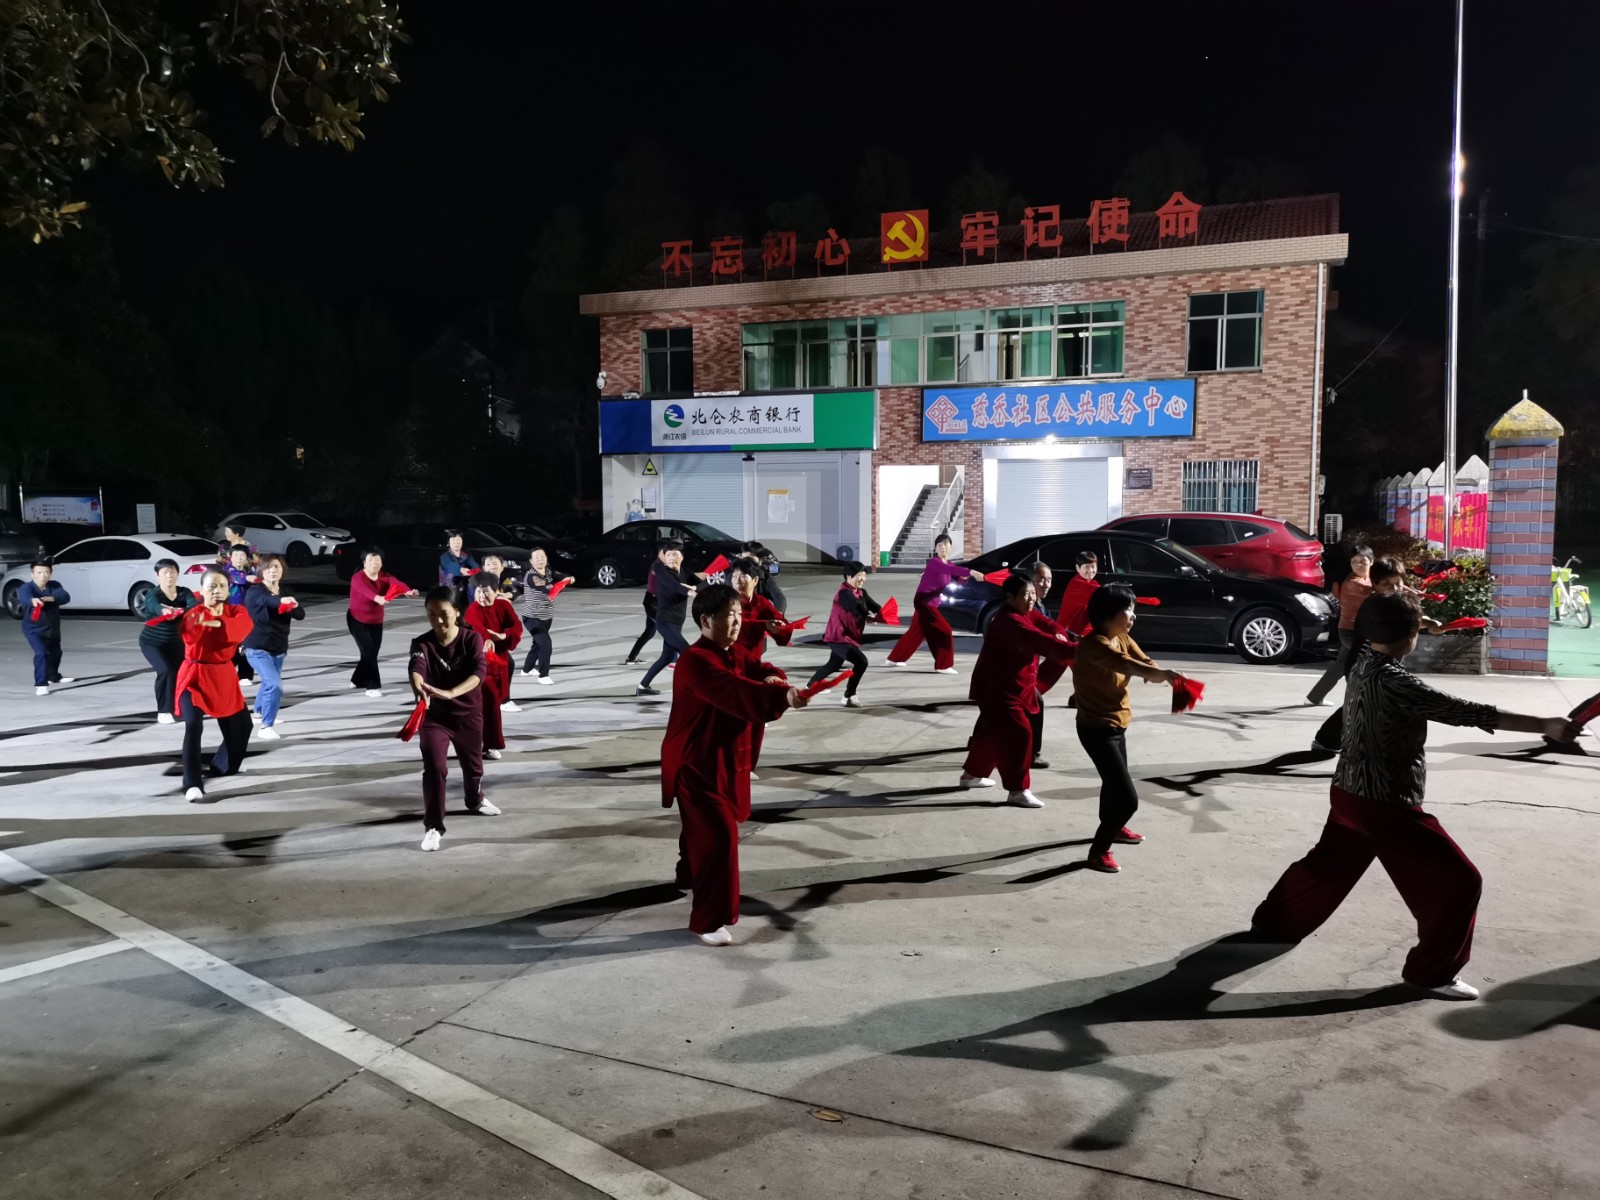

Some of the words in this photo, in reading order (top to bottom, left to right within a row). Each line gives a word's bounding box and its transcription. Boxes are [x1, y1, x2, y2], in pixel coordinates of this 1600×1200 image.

[661, 228, 852, 276] 不忘初心
[960, 191, 1203, 257] 牢记使命
[691, 406, 801, 425] 北仑农商银行
